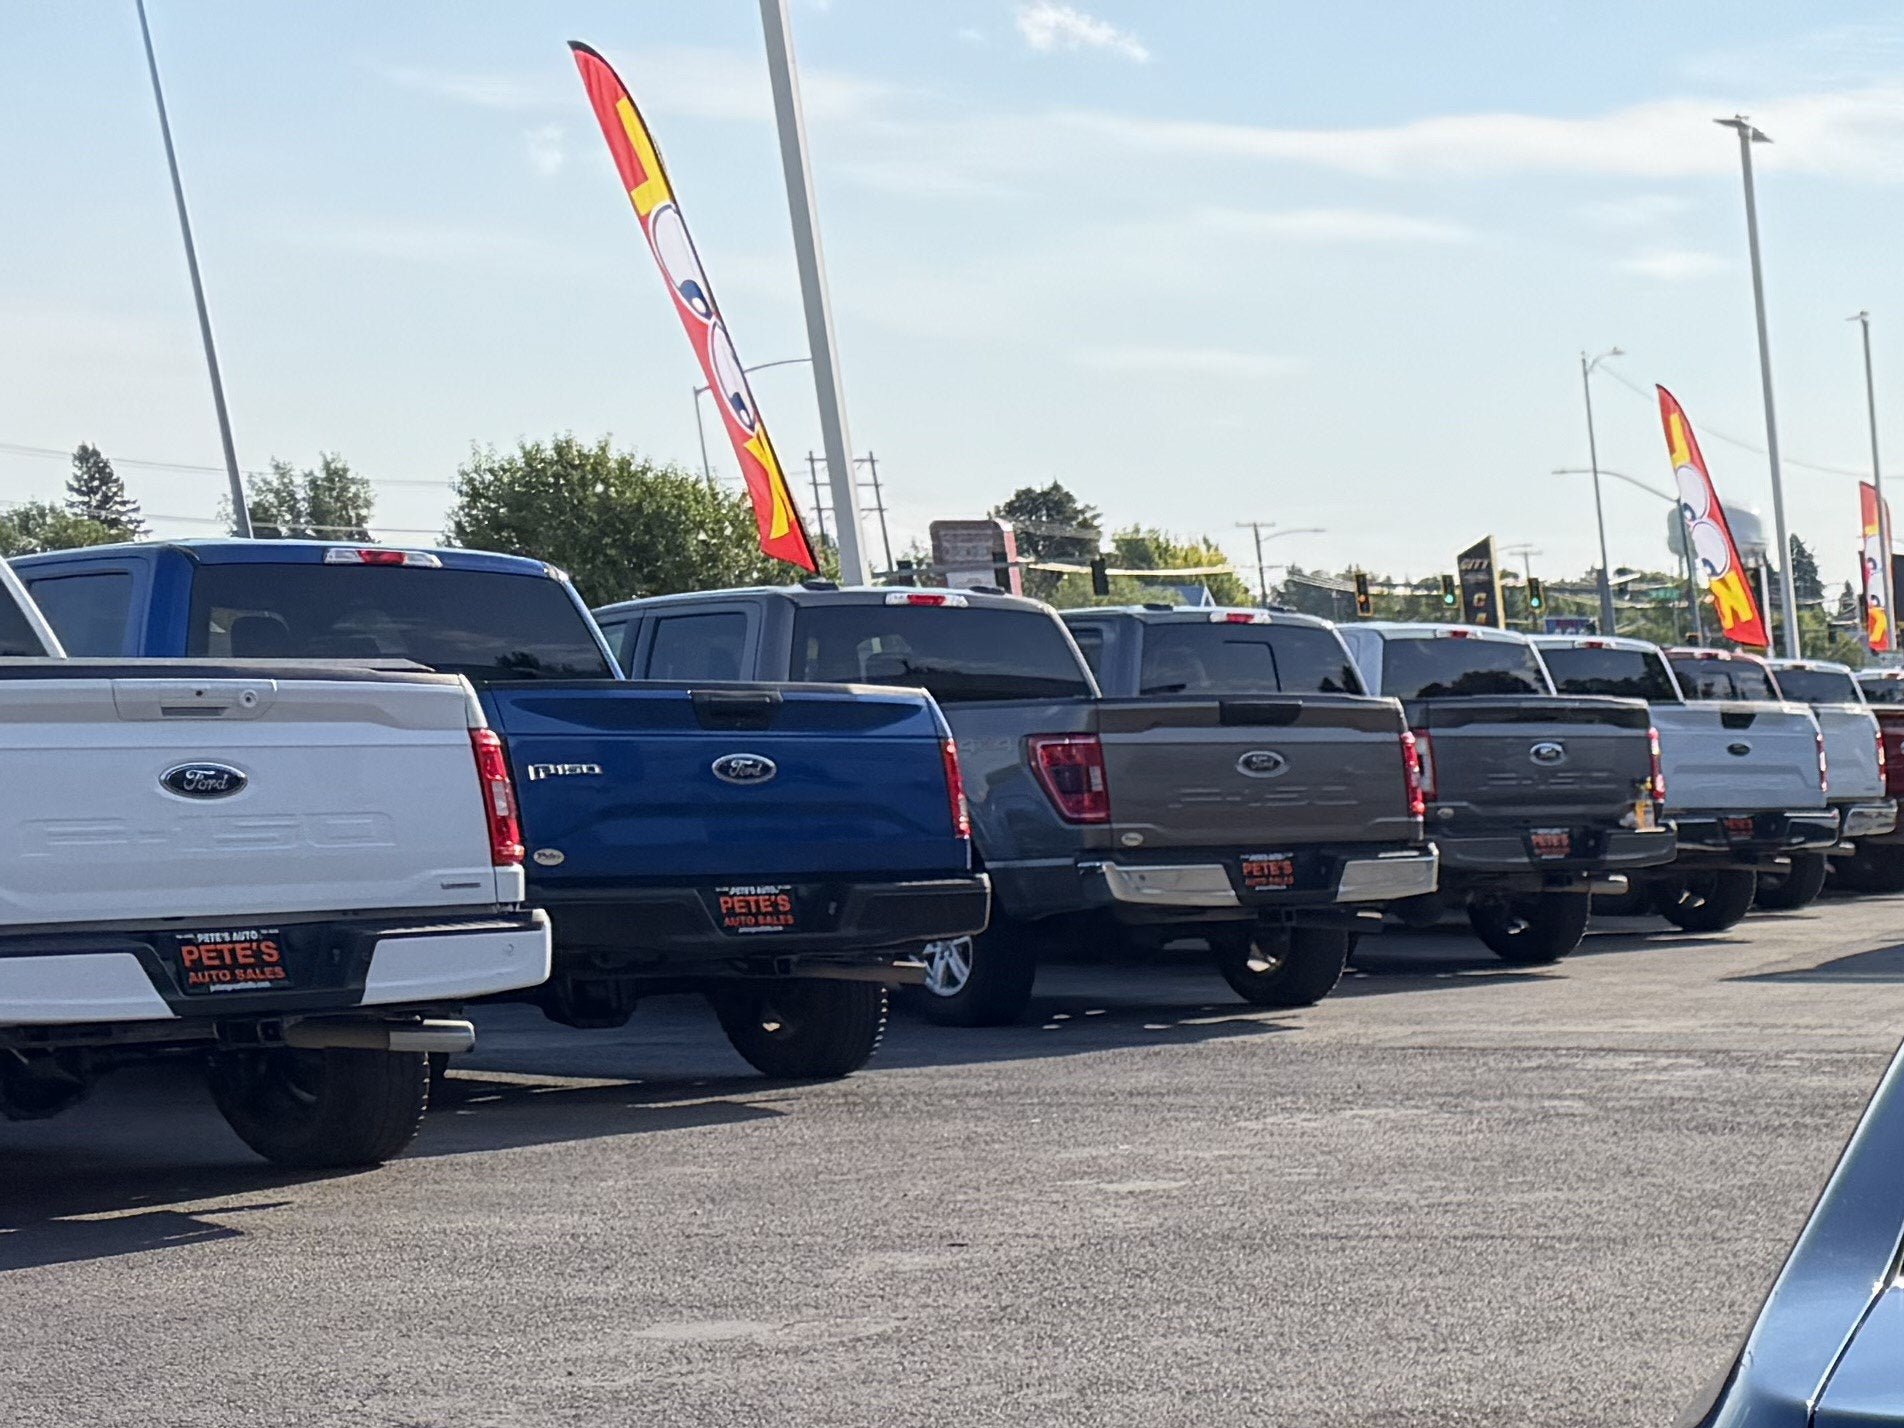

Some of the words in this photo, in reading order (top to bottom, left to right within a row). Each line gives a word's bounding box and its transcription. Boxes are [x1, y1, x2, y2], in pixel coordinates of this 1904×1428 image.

[183, 769, 229, 791] Ford
[720, 894, 791, 913] PETE'S
[181, 940, 280, 968] PETE'S
[189, 969, 231, 985] AUTO
[235, 966, 286, 981] SALES
